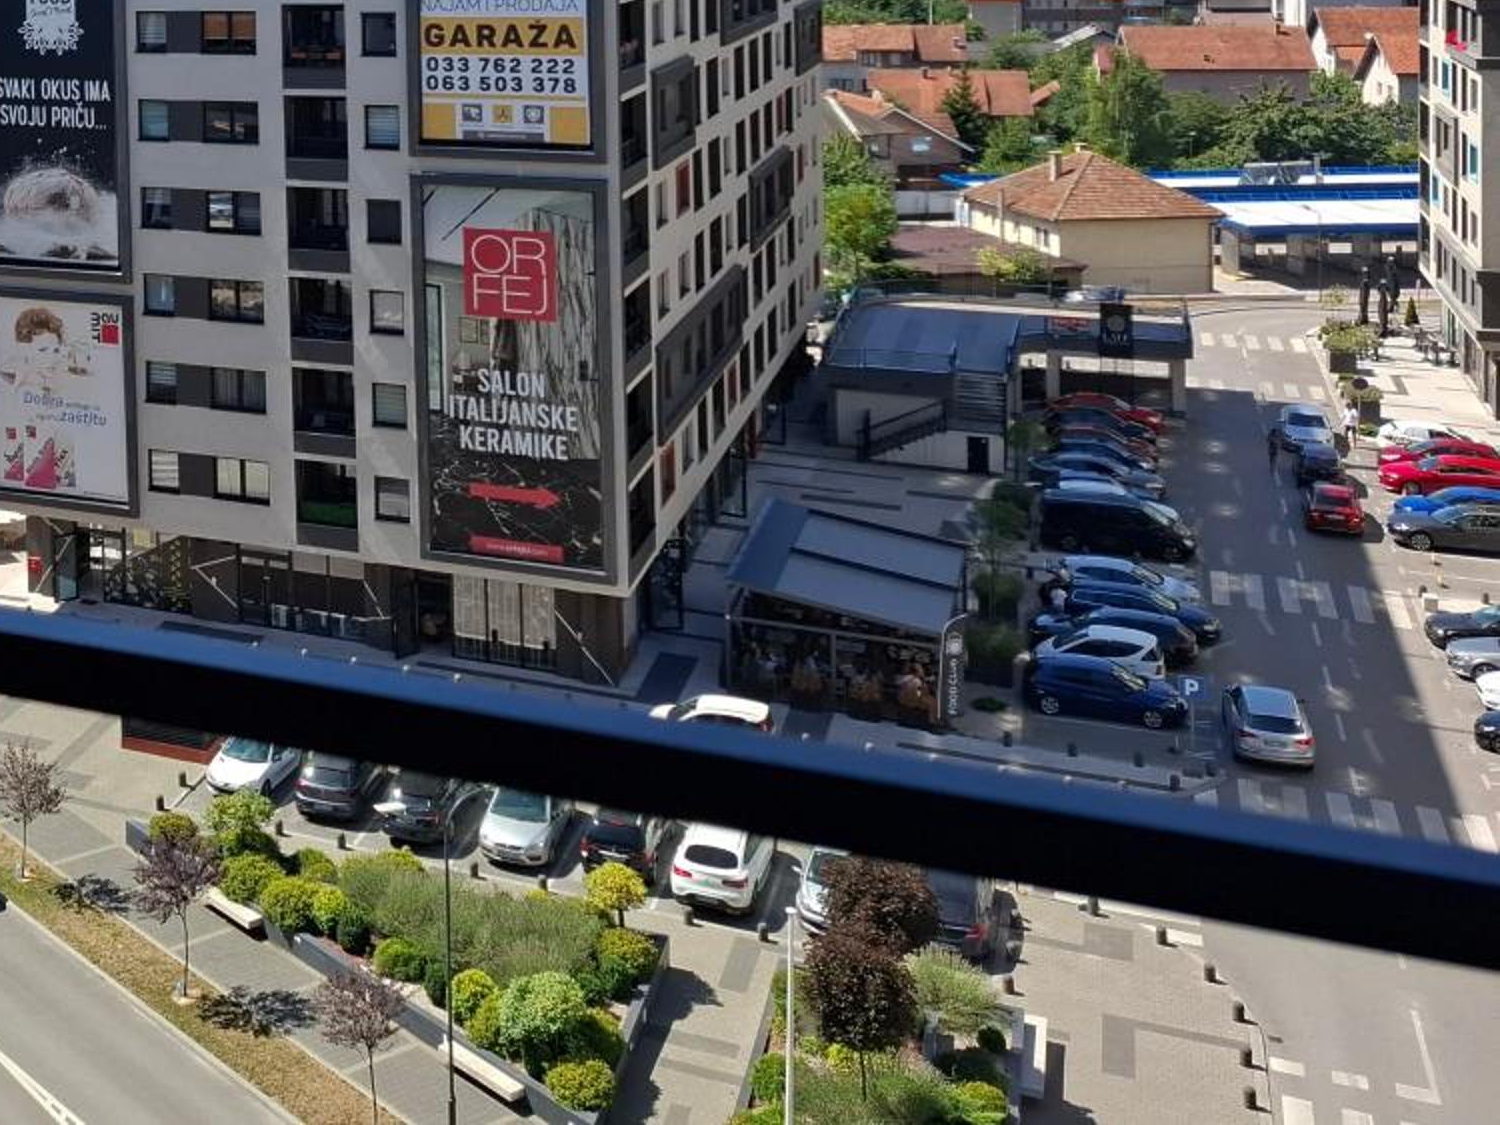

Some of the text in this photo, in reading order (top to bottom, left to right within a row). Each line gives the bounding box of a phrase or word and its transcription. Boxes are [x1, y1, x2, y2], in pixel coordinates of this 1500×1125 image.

[423, 20, 578, 49] GARAŽA
[425, 56, 575, 74] 033 762 222
[41, 77, 81, 102] OKUS
[84, 79, 111, 103] IMA
[425, 75, 578, 94] 063 503 378
[0, 104, 47, 128] SVOJU
[476, 368, 546, 398] SALON
[447, 394, 578, 433] ITALIJANSKE
[459, 425, 569, 462] KERAMIKE
[1184, 678, 1200, 696] P
